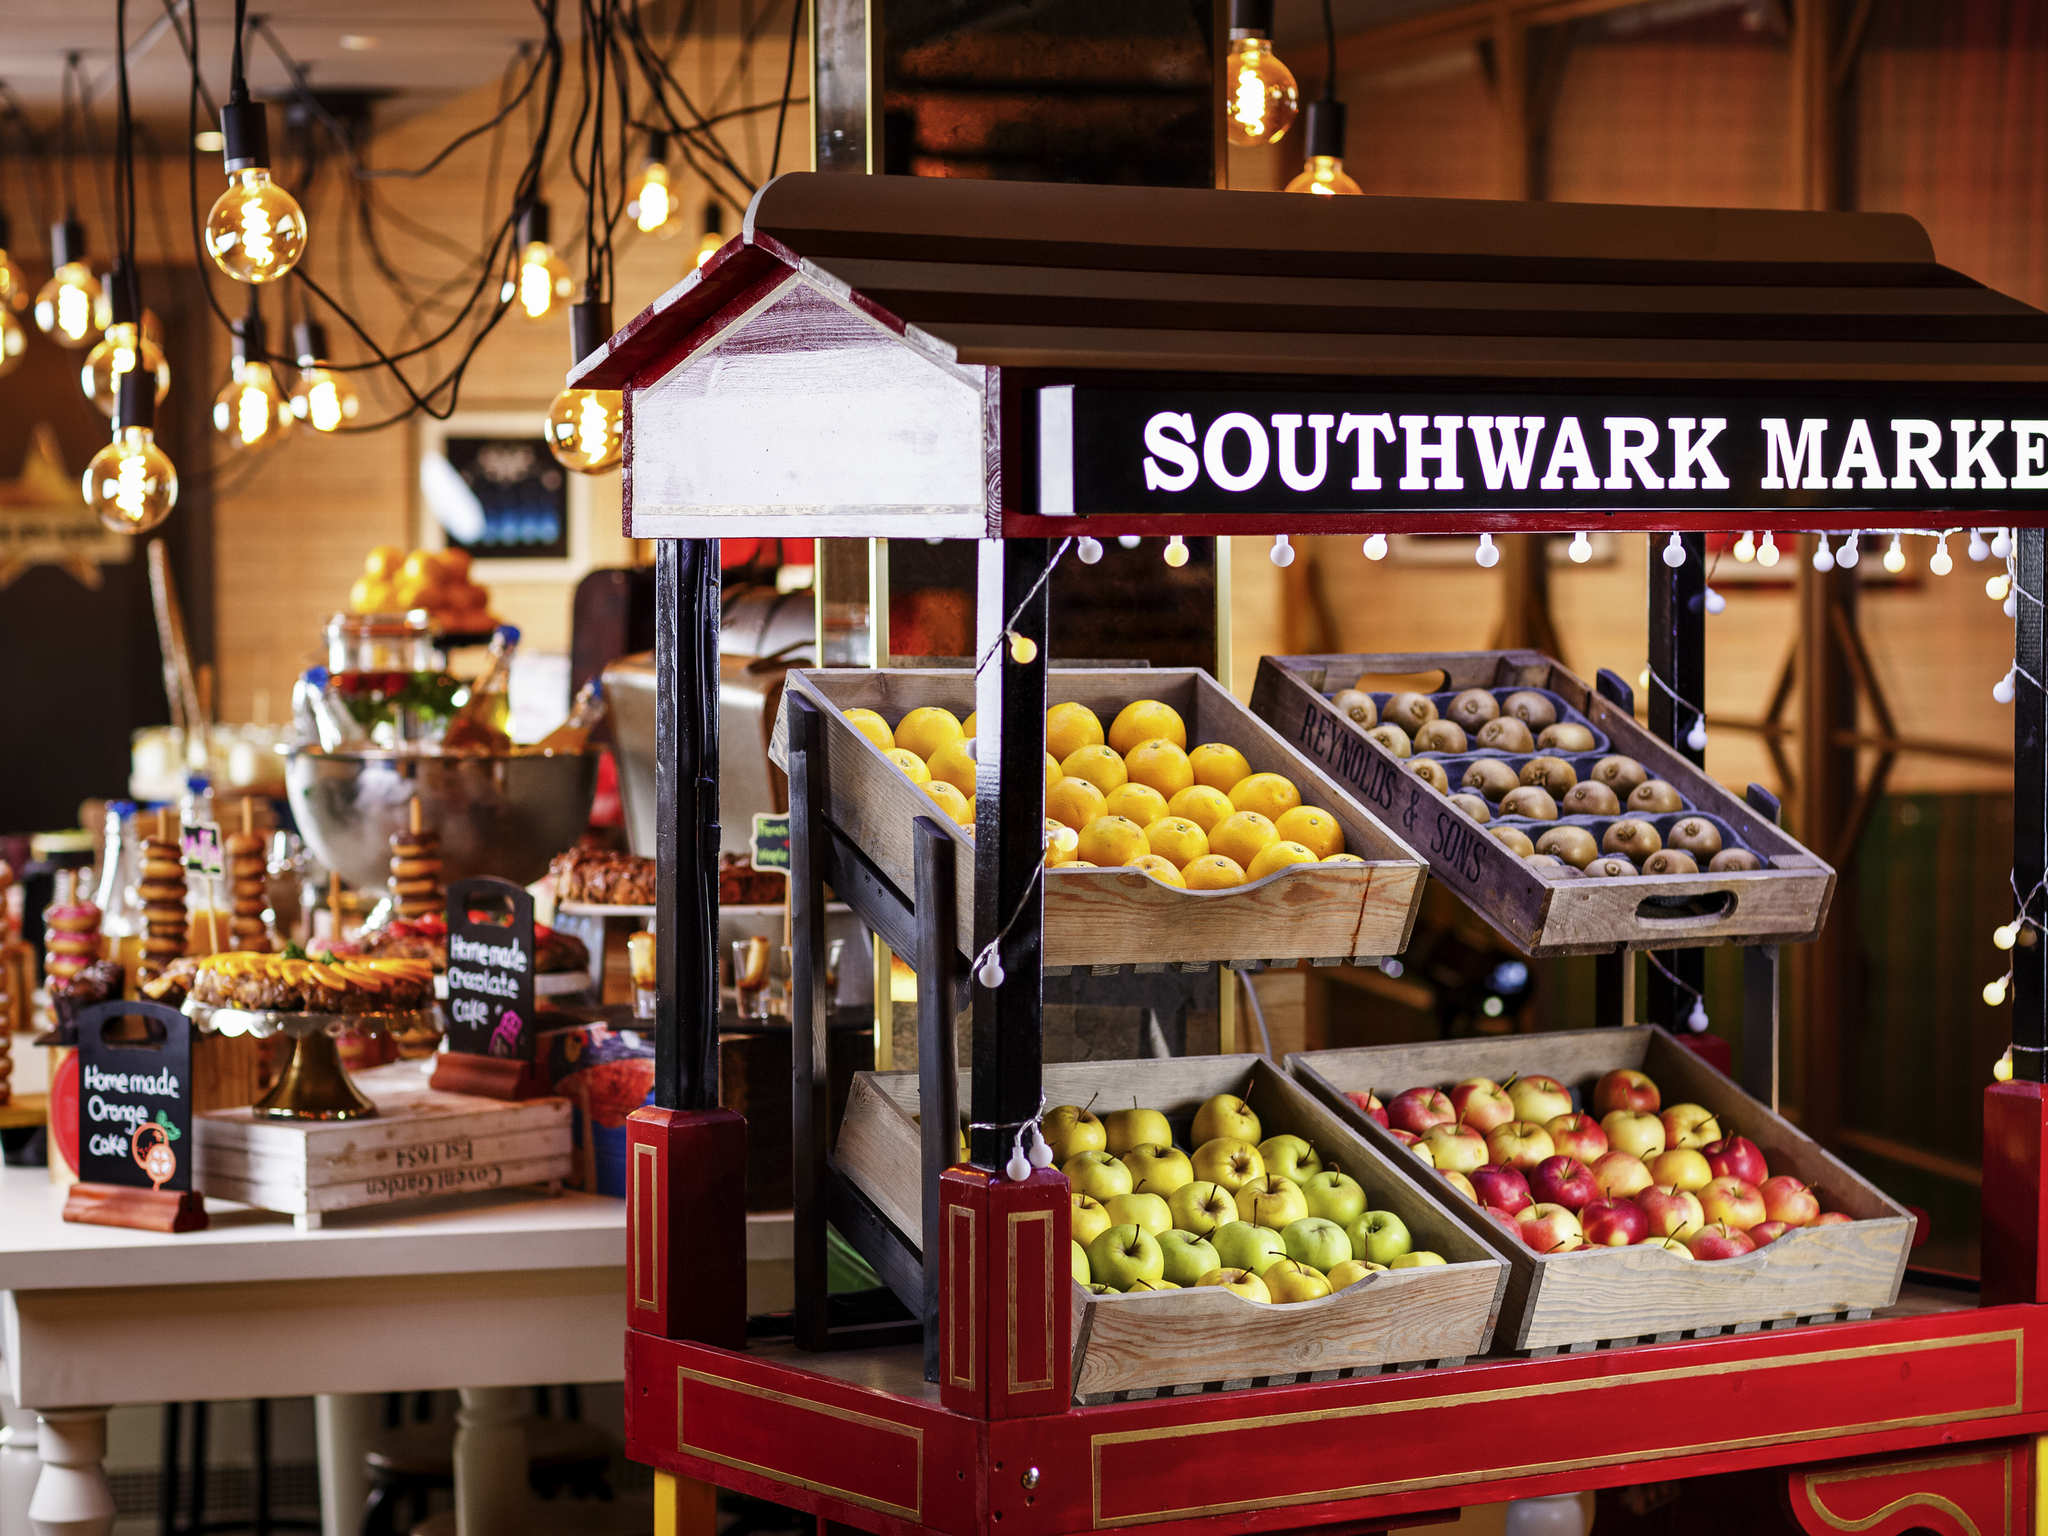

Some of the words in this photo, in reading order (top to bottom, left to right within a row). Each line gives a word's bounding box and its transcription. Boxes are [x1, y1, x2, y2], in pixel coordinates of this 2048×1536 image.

[1143, 411, 1730, 492] SOUTHWARK
[1760, 416, 2048, 491] MARKE
[1301, 703, 1398, 811] REYNOLDS
[1402, 789, 1421, 832] &
[1430, 811, 1488, 883] SONS
[87, 1094, 149, 1136] Orange
[366, 1174, 433, 1198] Garden
